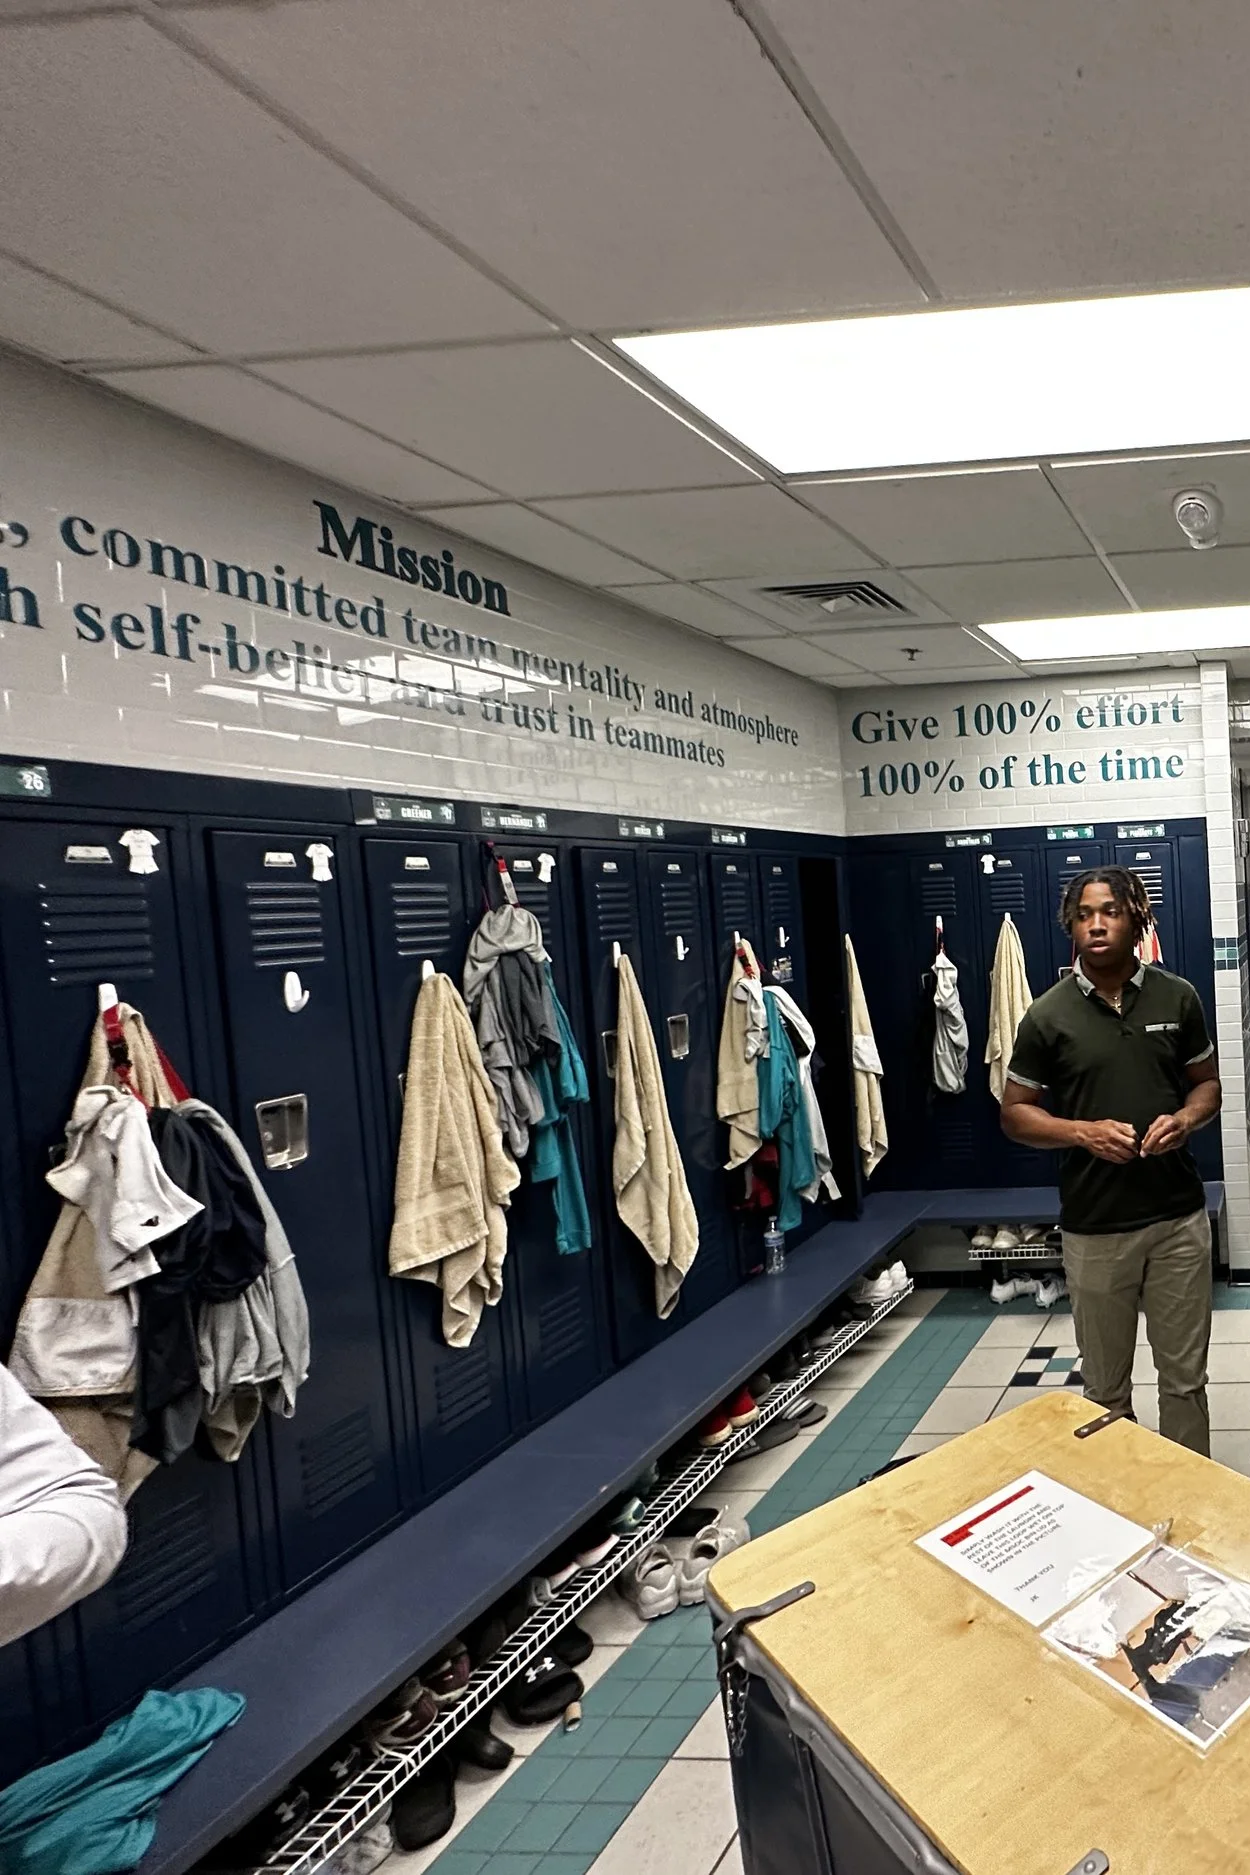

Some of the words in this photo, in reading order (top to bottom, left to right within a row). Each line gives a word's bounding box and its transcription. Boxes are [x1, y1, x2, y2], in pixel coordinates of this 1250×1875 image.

[312, 500, 511, 616] Mission
[60, 516, 388, 638] committed
[401, 608, 498, 662] team
[512, 646, 646, 712] mentality
[655, 686, 694, 719] and
[701, 702, 799, 747] atmosphere
[391, 680, 466, 717] and
[479, 696, 560, 734] trust
[568, 705, 596, 742] in
[604, 717, 726, 768] teammates
[851, 709, 939, 744] Give
[952, 698, 1061, 738] 100%
[1076, 693, 1185, 730] effort
[859, 759, 965, 798] 100%
[979, 755, 1018, 790] of
[1027, 754, 1087, 786] the
[1099, 749, 1185, 782] time
[1028, 1502, 1041, 1511] THE
[967, 1548, 984, 1560] REST
[994, 1533, 1007, 1542] THE
[1021, 1540, 1035, 1550] THE
[1015, 1574, 1039, 1592] THANK
[1038, 1564, 1054, 1575] YOU
